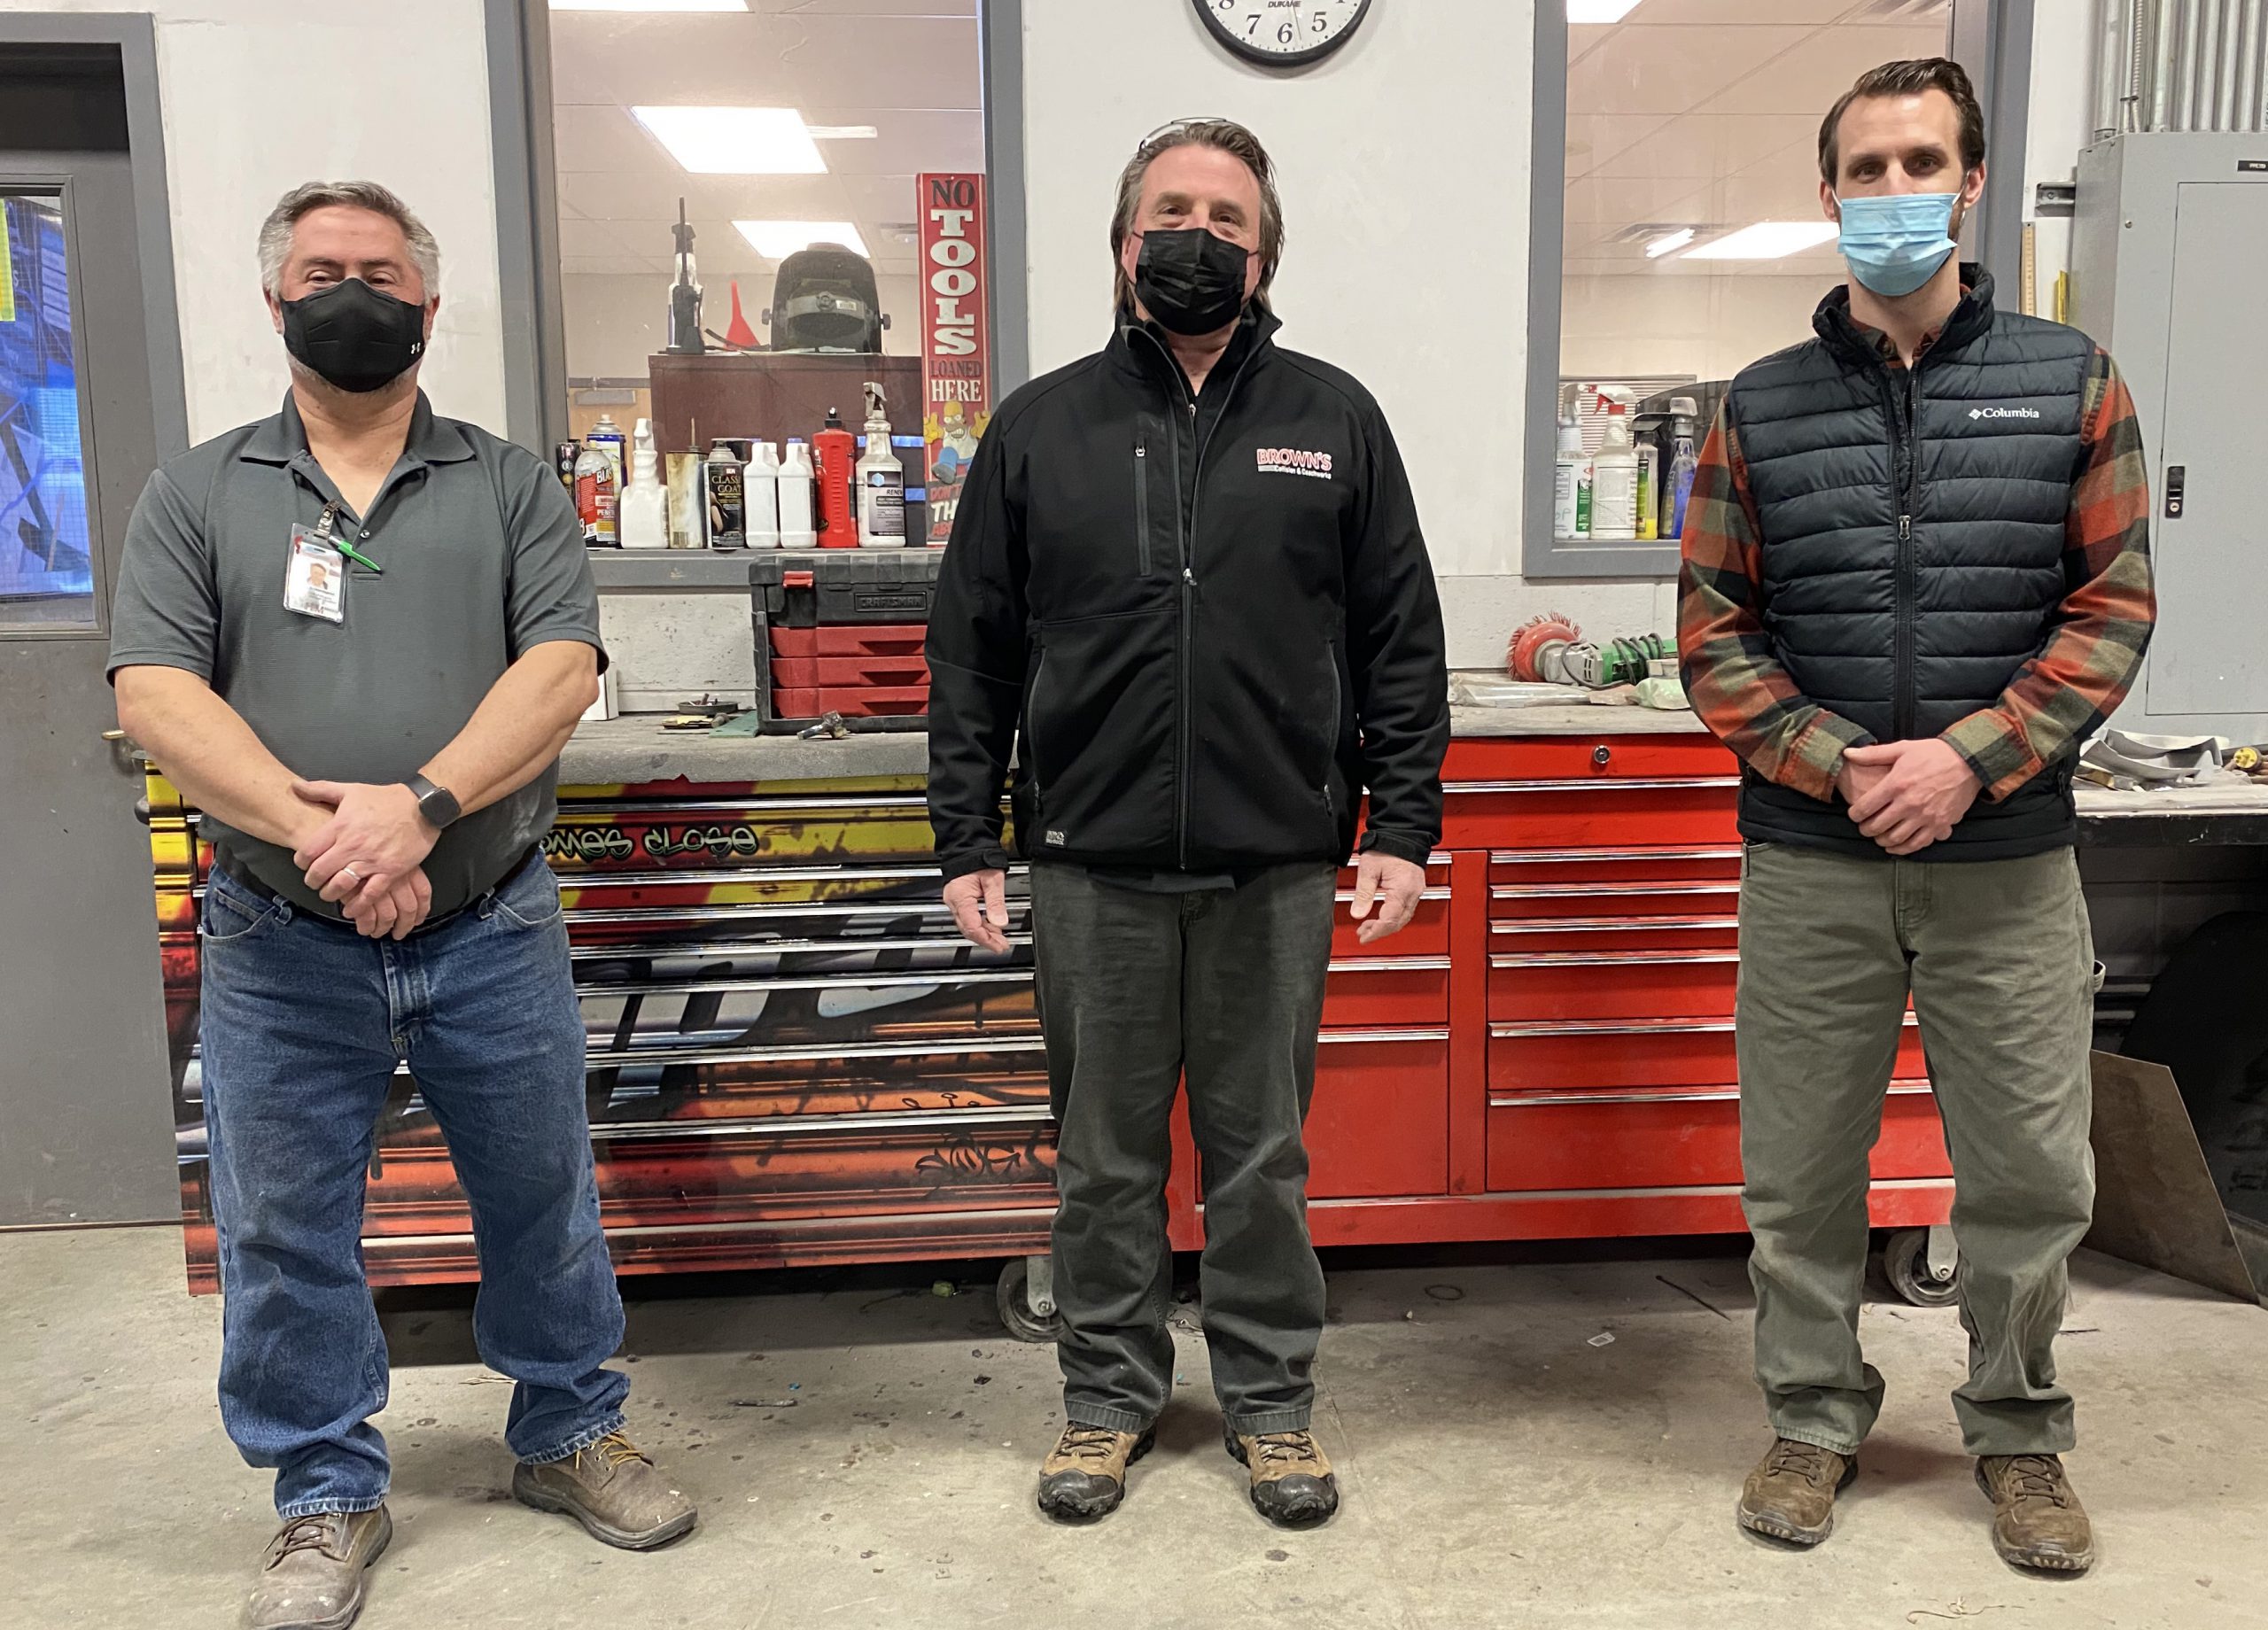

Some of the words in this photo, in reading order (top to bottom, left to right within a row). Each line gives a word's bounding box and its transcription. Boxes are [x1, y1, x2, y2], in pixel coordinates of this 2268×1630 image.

[1246, 14, 1262, 35] 7
[1277, 23, 1293, 43] 6
[1311, 12, 1327, 32] 5
[930, 179, 975, 206] NO
[930, 208, 977, 355] TOOLS
[930, 360, 982, 377] LOANED
[931, 379, 982, 402] HERE
[1982, 407, 2039, 418] Columbia
[1256, 447, 1332, 471] BROWN'S
[930, 498, 959, 523] TH
